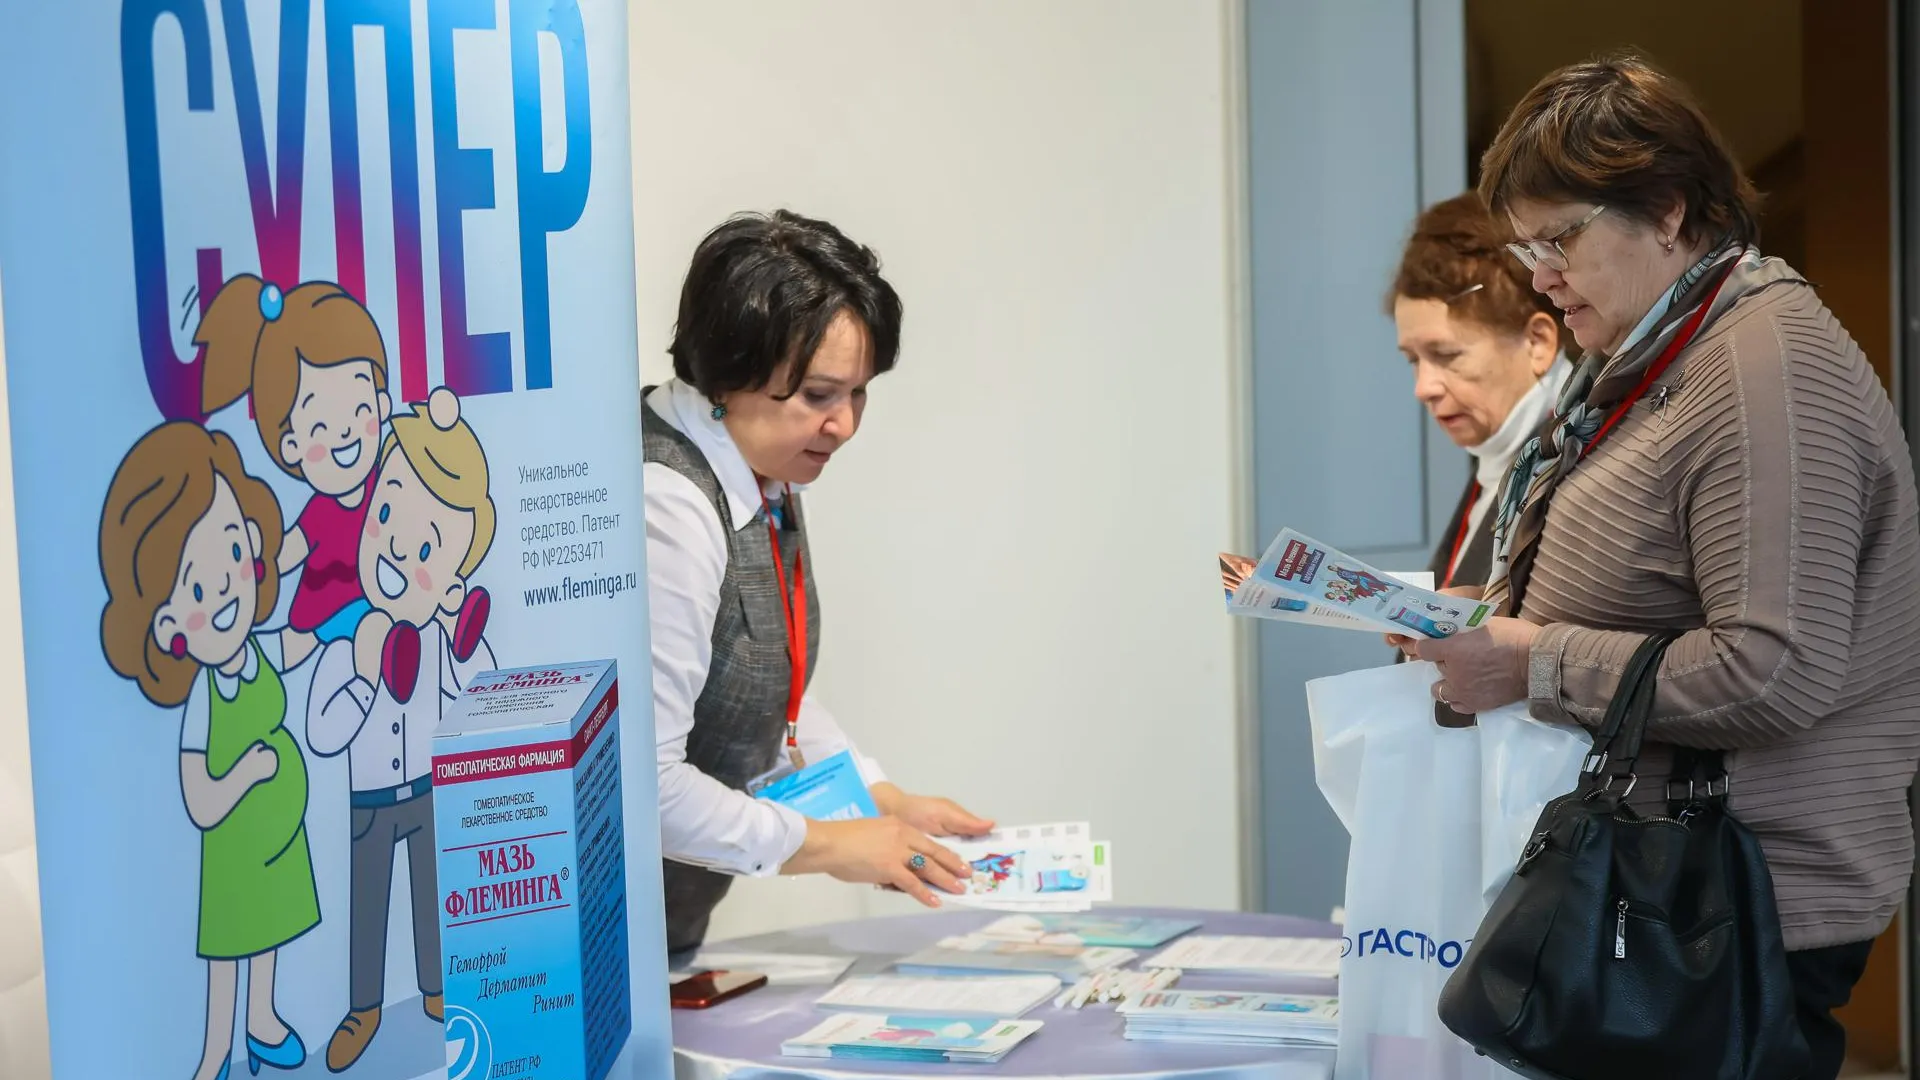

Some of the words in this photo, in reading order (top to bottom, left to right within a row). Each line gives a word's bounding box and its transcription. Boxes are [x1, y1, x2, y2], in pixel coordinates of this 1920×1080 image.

[120, 0, 592, 424] СУПЕР
[518, 461, 589, 485] Уникальное
[519, 487, 608, 514] лекарственное
[521, 519, 579, 545] средство.
[582, 513, 620, 533] Патент
[522, 550, 540, 570] РФ
[542, 540, 604, 567] №2253471
[524, 571, 637, 607] www.fleminga.ru
[505, 670, 562, 682] МАЗЬ
[437, 755, 516, 779] ГОМЕОПАТИЧЕСКАЯ
[518, 748, 565, 768] ФАРМАЦИЯ
[473, 791, 534, 811] ГОМЕОПАТИЧЕСКОЕ
[461, 810, 513, 829] ЛЕКАРСТВЕННОЕ
[515, 805, 548, 821] СРЕДСТВО
[479, 843, 535, 878] МАЗЬ
[448, 946, 507, 976] Геморрой
[477, 971, 547, 1002] Дерматит
[533, 992, 575, 1014] Ринит
[492, 1057, 528, 1079] ПАТЕНТ
[529, 1055, 541, 1070] РФ
